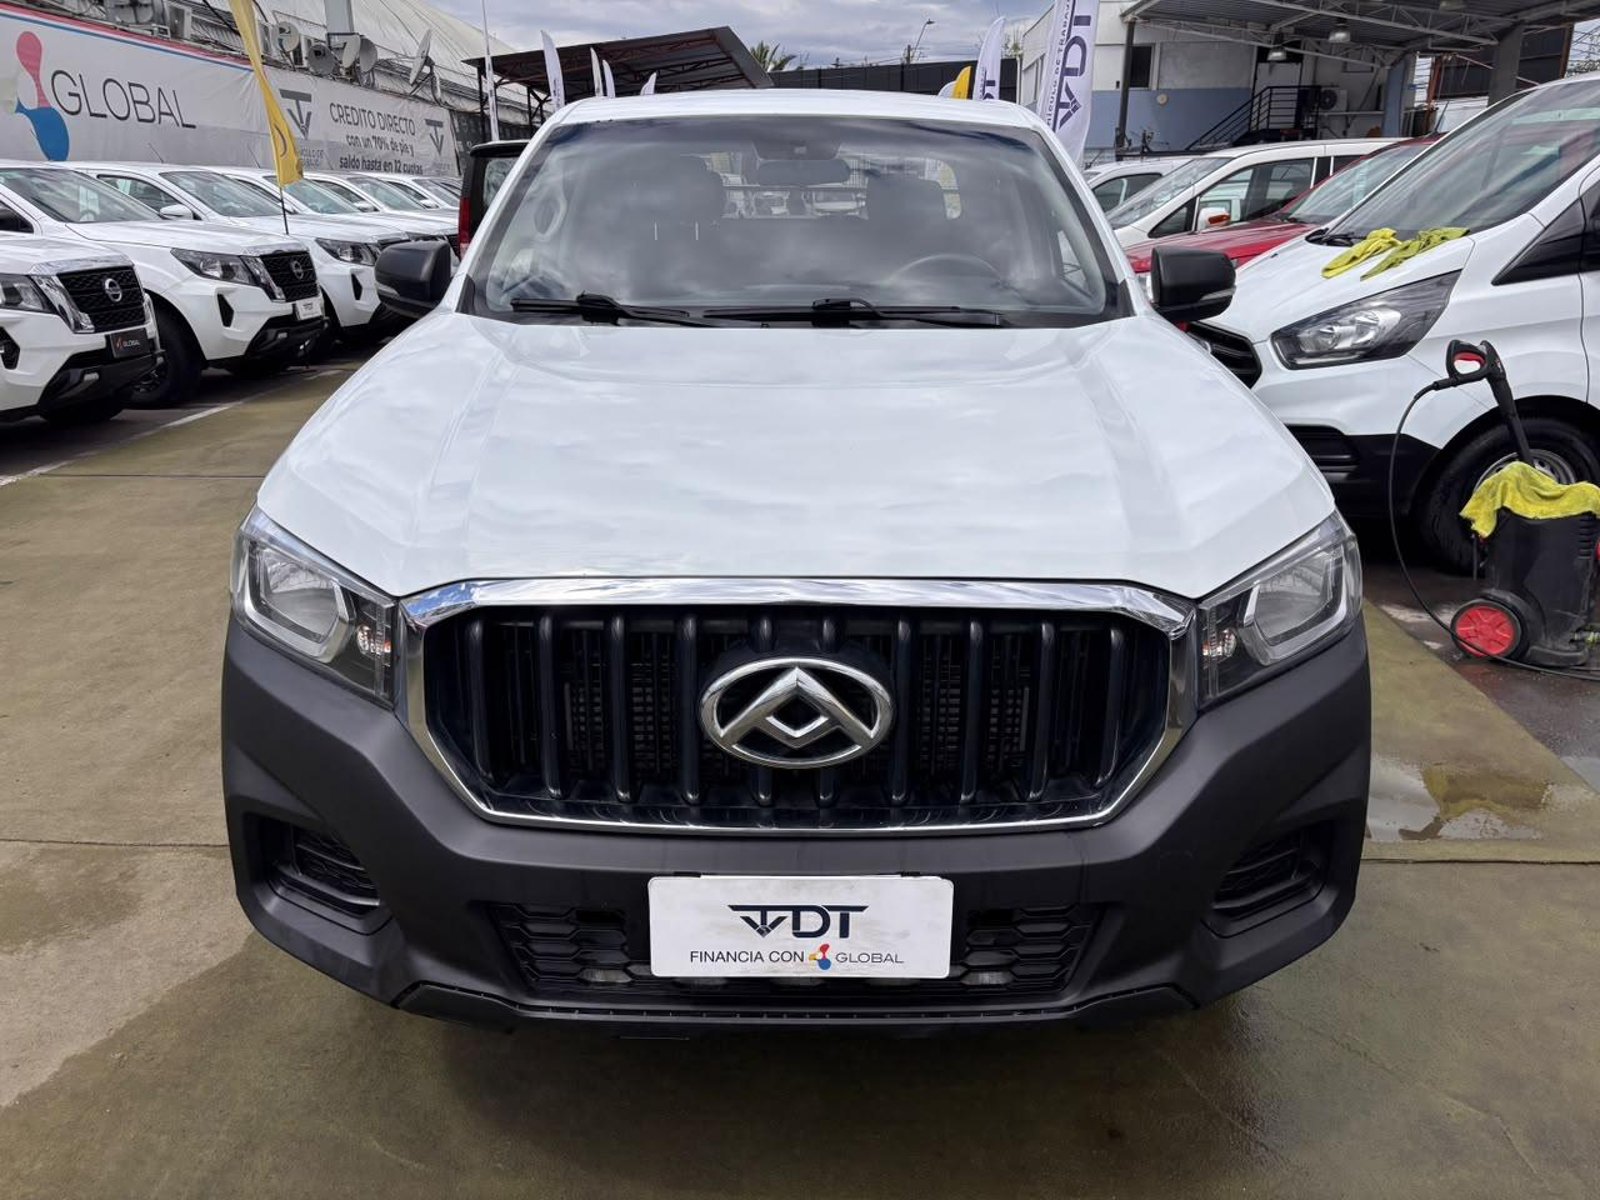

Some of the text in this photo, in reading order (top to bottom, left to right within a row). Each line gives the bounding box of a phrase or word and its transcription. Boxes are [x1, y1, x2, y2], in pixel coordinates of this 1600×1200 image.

[51, 69, 197, 129] GLOBAL
[329, 102, 416, 136] CREDITO DIRECTO
[340, 154, 360, 170] saldo
[361, 156, 382, 171] hasta
[383, 159, 393, 173] en
[394, 159, 402, 174] 12
[689, 950, 904, 964] FINANCIA CON GLOBAL
